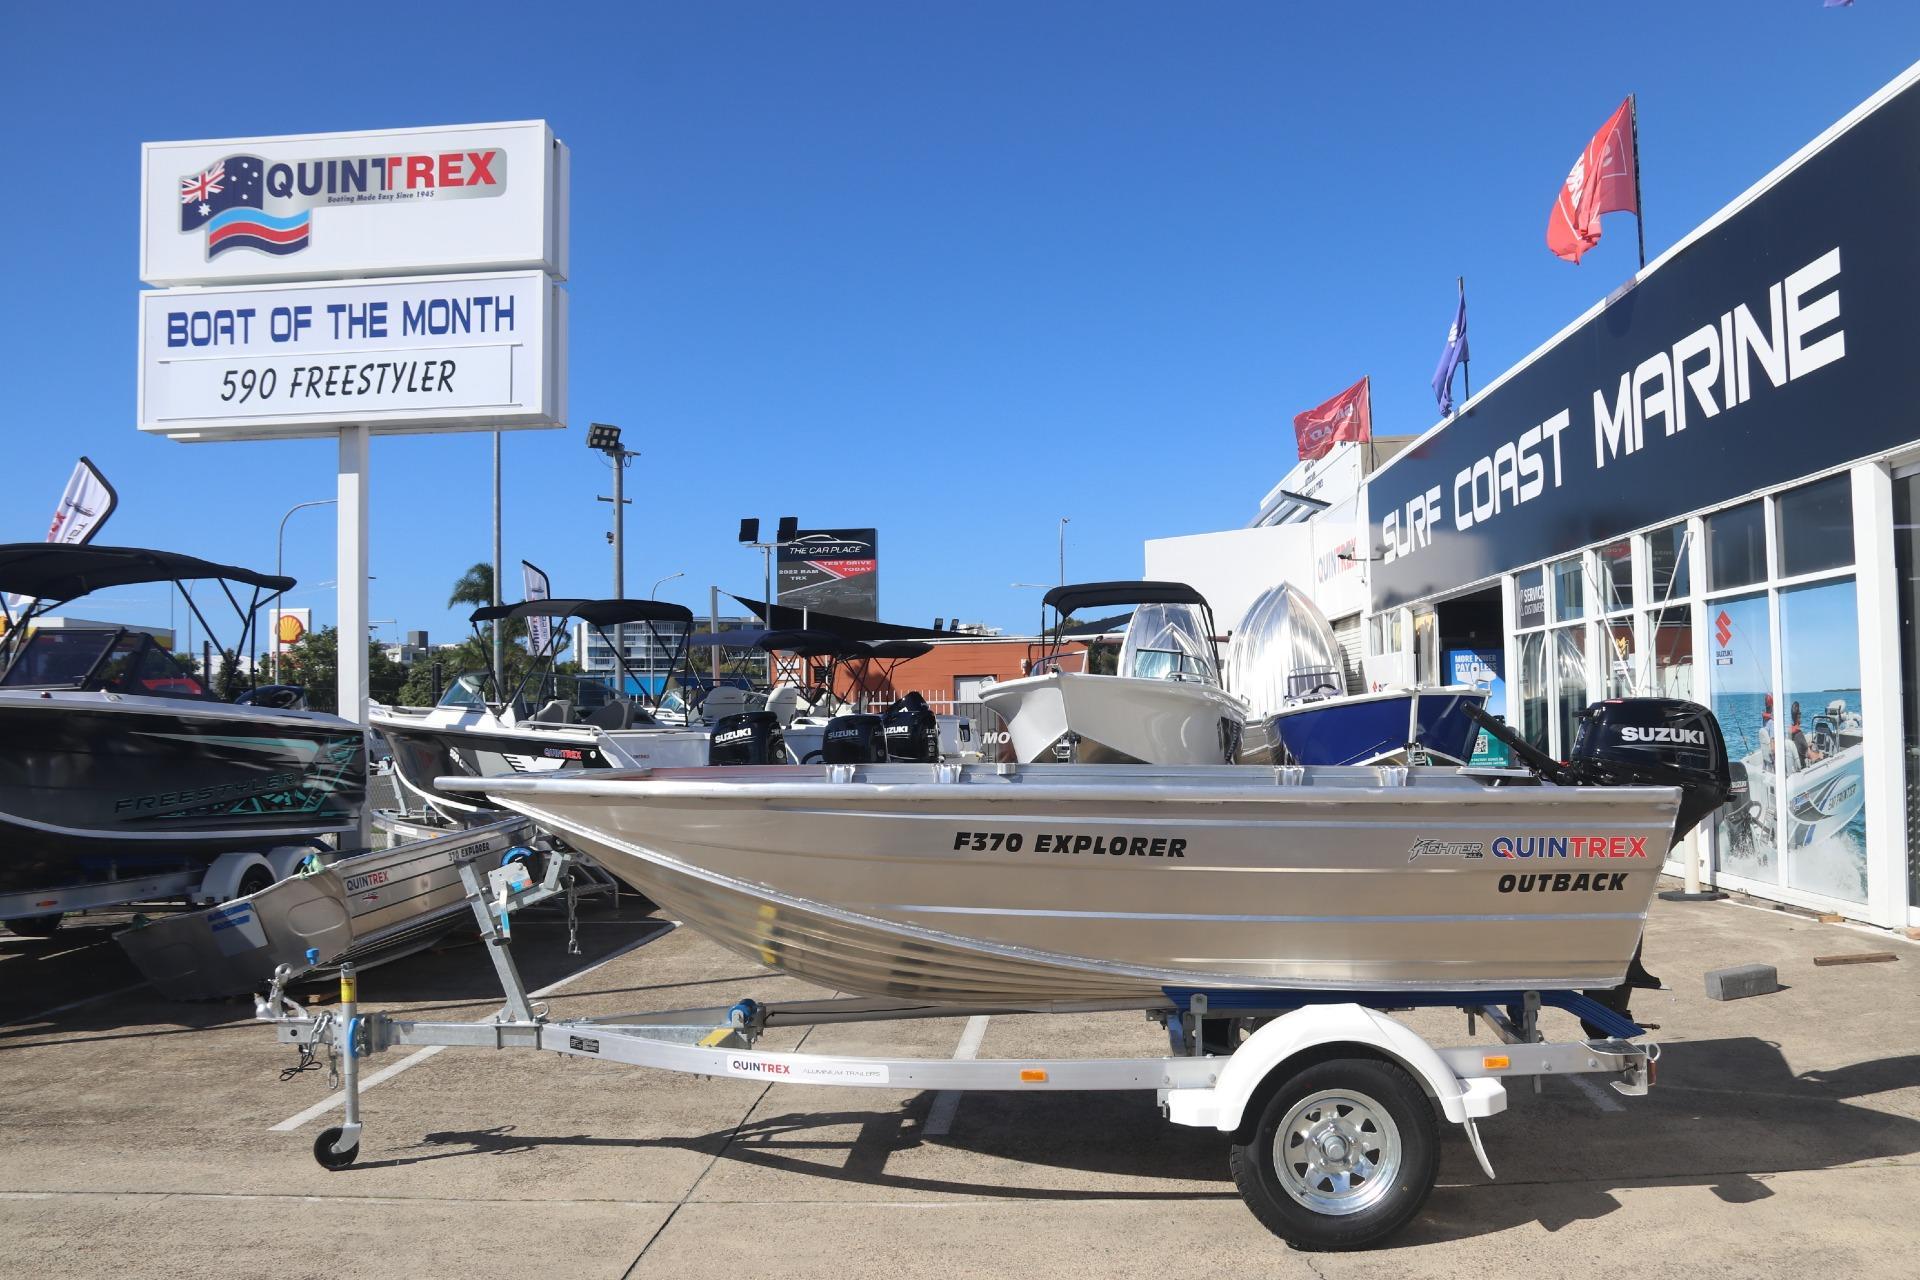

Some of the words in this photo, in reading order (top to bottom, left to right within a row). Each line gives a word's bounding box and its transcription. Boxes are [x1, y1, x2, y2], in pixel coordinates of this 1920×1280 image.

[266, 151, 497, 199] QUINTREX
[328, 195, 354, 203] Boating
[357, 193, 376, 201] Made
[378, 192, 394, 201] Easy
[396, 191, 414, 199] Since
[416, 190, 435, 198] 1945
[167, 308, 256, 348] BOAT
[270, 305, 312, 343] OF
[327, 301, 388, 340] THE
[403, 294, 515, 337] MONTH
[220, 367, 277, 404] 590
[290, 359, 457, 400] FREESTYLER
[1382, 484, 1441, 566] SURF
[1453, 408, 1571, 533] COAST
[1592, 245, 1846, 470] MARINE
[789, 547, 809, 555] THE
[809, 546, 830, 554] CAR
[830, 545, 861, 553] PLACE
[1455, 655, 1473, 663] MORE
[1455, 663, 1471, 673] PAY
[715, 727, 752, 744] SUZUKI
[828, 729, 859, 740] SUZUKI
[884, 721, 909, 733] UZUKI
[1621, 727, 1705, 745] SUZUKI
[114, 773, 297, 813] FREESTYLER
[461, 842, 491, 857] EXPLORER
[953, 831, 1024, 852] F370
[1034, 834, 1187, 858] EXPLORER
[1407, 835, 1484, 863] FIGHTER
[1491, 836, 1648, 860] QUINTREX
[346, 871, 389, 891] QUINTREX
[1498, 872, 1629, 893] OUTBACK
[733, 1060, 791, 1075] QUINTREX
